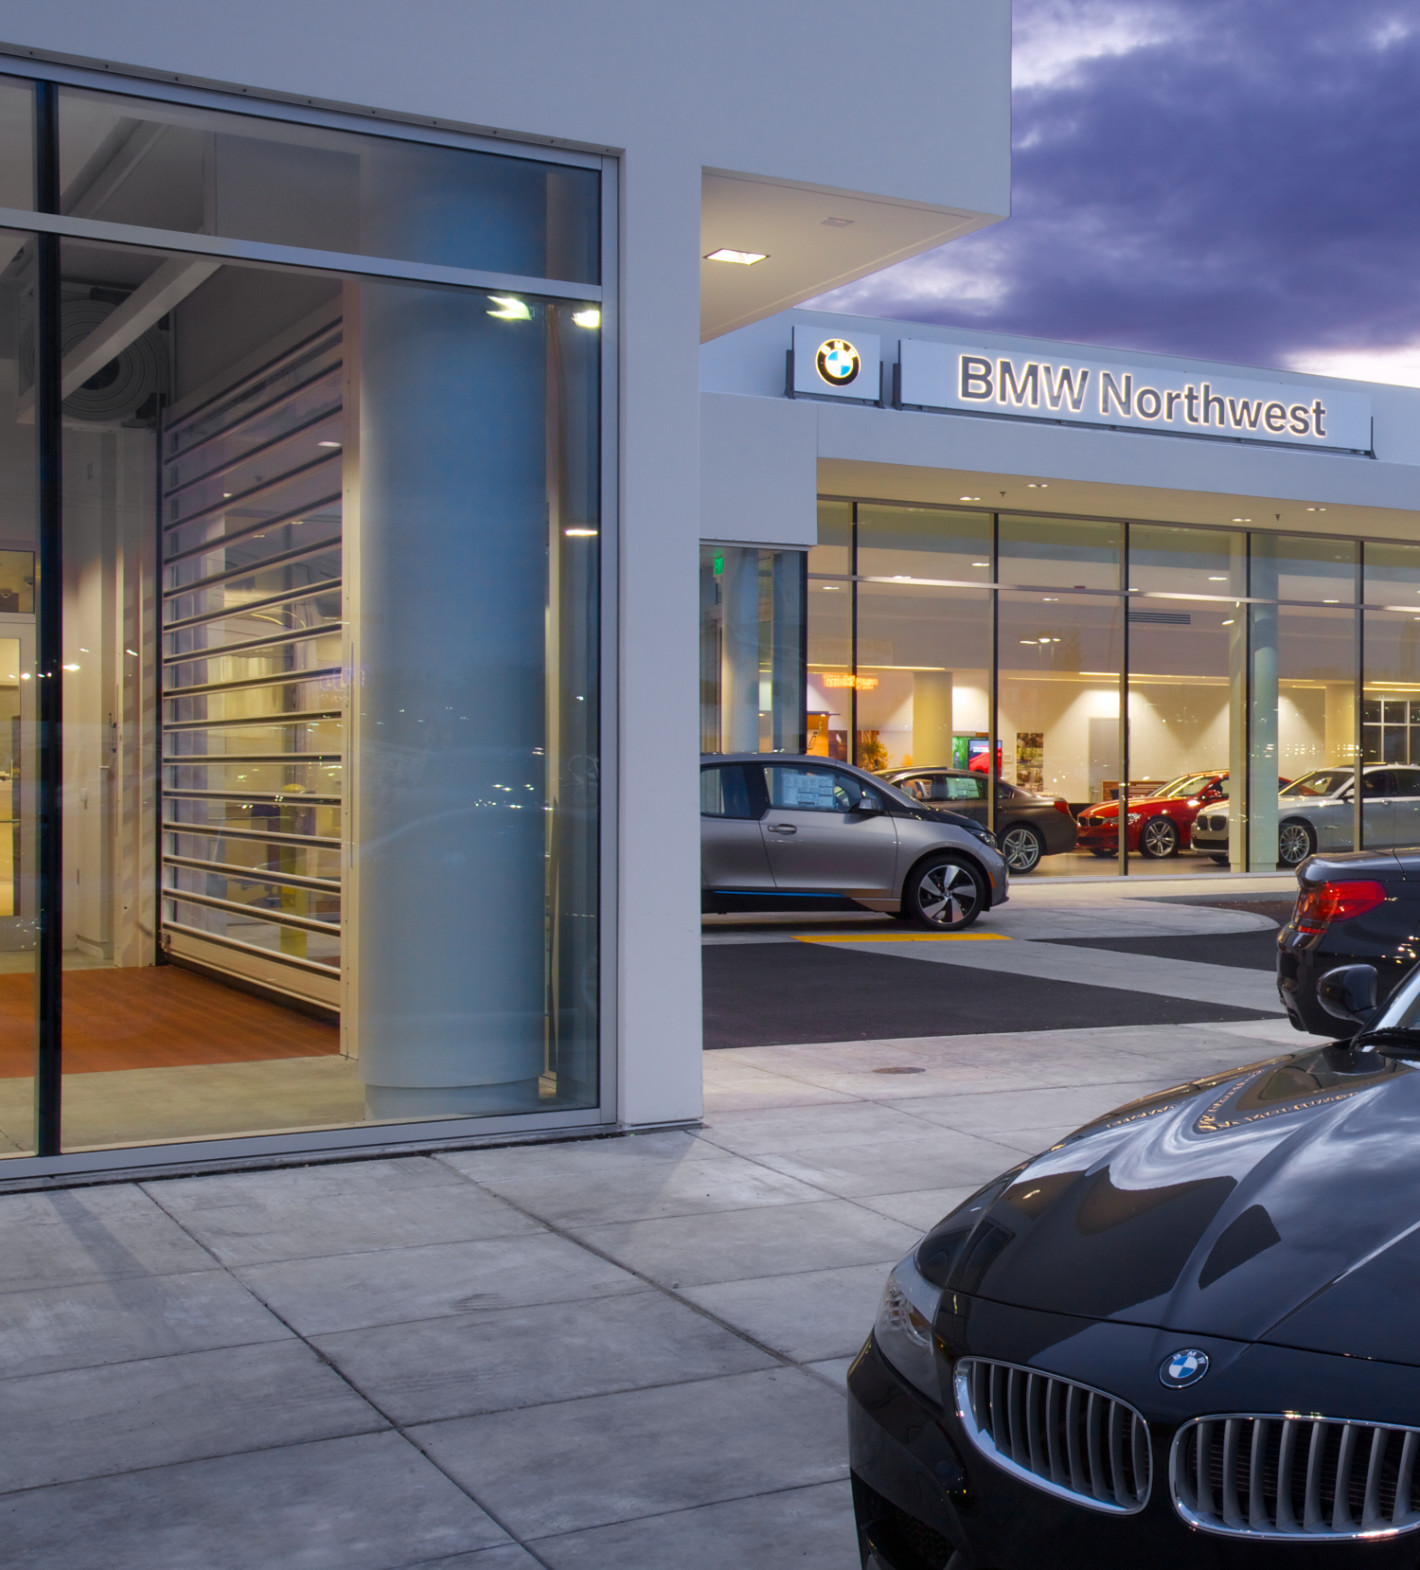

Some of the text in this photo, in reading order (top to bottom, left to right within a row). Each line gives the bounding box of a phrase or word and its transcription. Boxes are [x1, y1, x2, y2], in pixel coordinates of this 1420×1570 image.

[820, 340, 858, 359] BMW
[960, 355, 1326, 437] BMW Northwest
[1173, 1351, 1206, 1364] BMW
